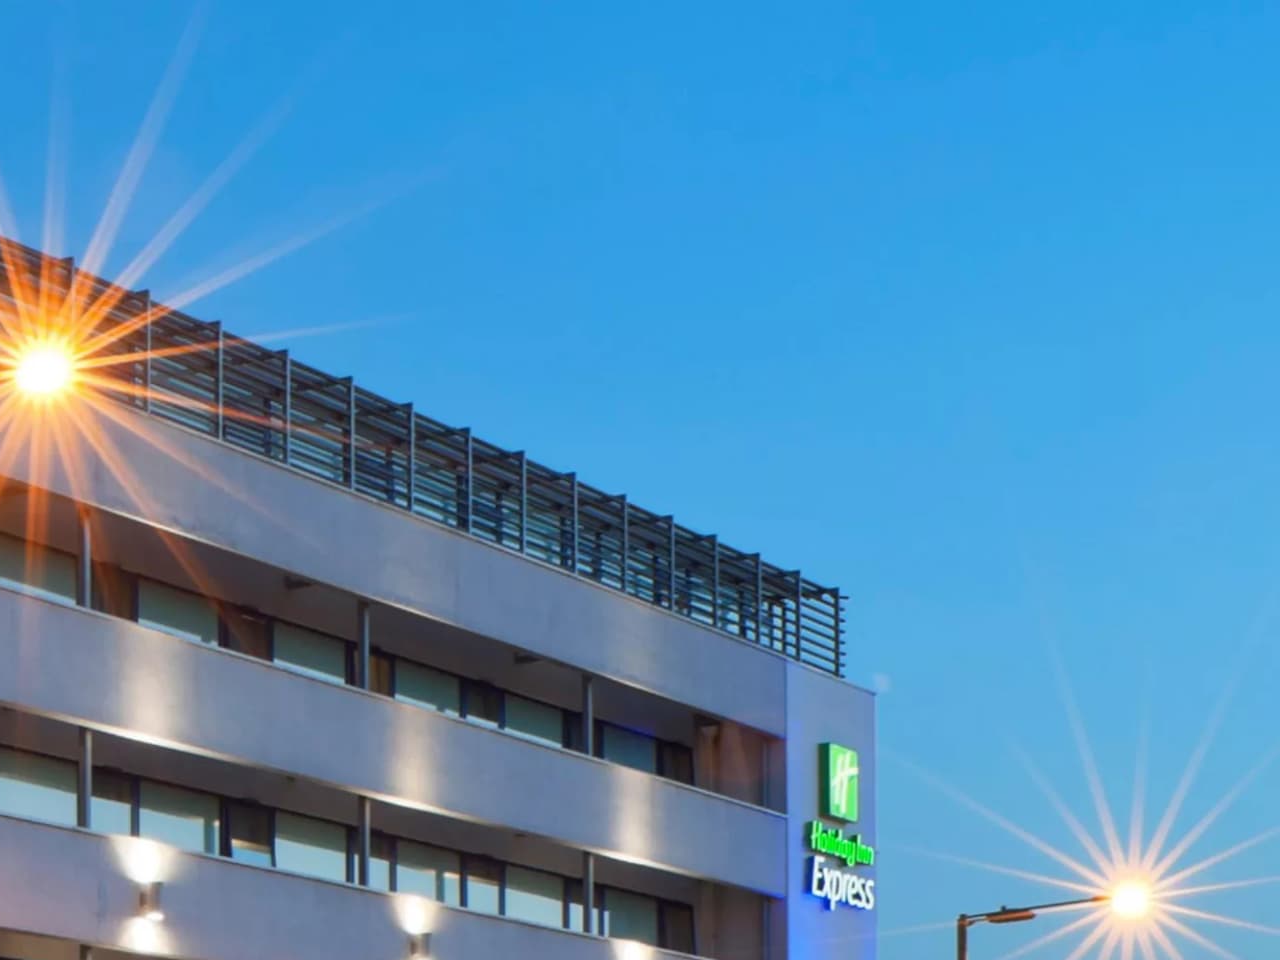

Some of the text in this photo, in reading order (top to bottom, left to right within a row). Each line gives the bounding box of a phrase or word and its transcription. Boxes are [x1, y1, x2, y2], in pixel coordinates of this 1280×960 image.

[810, 819, 875, 868] Holiday Inn
[810, 854, 875, 911] Express
